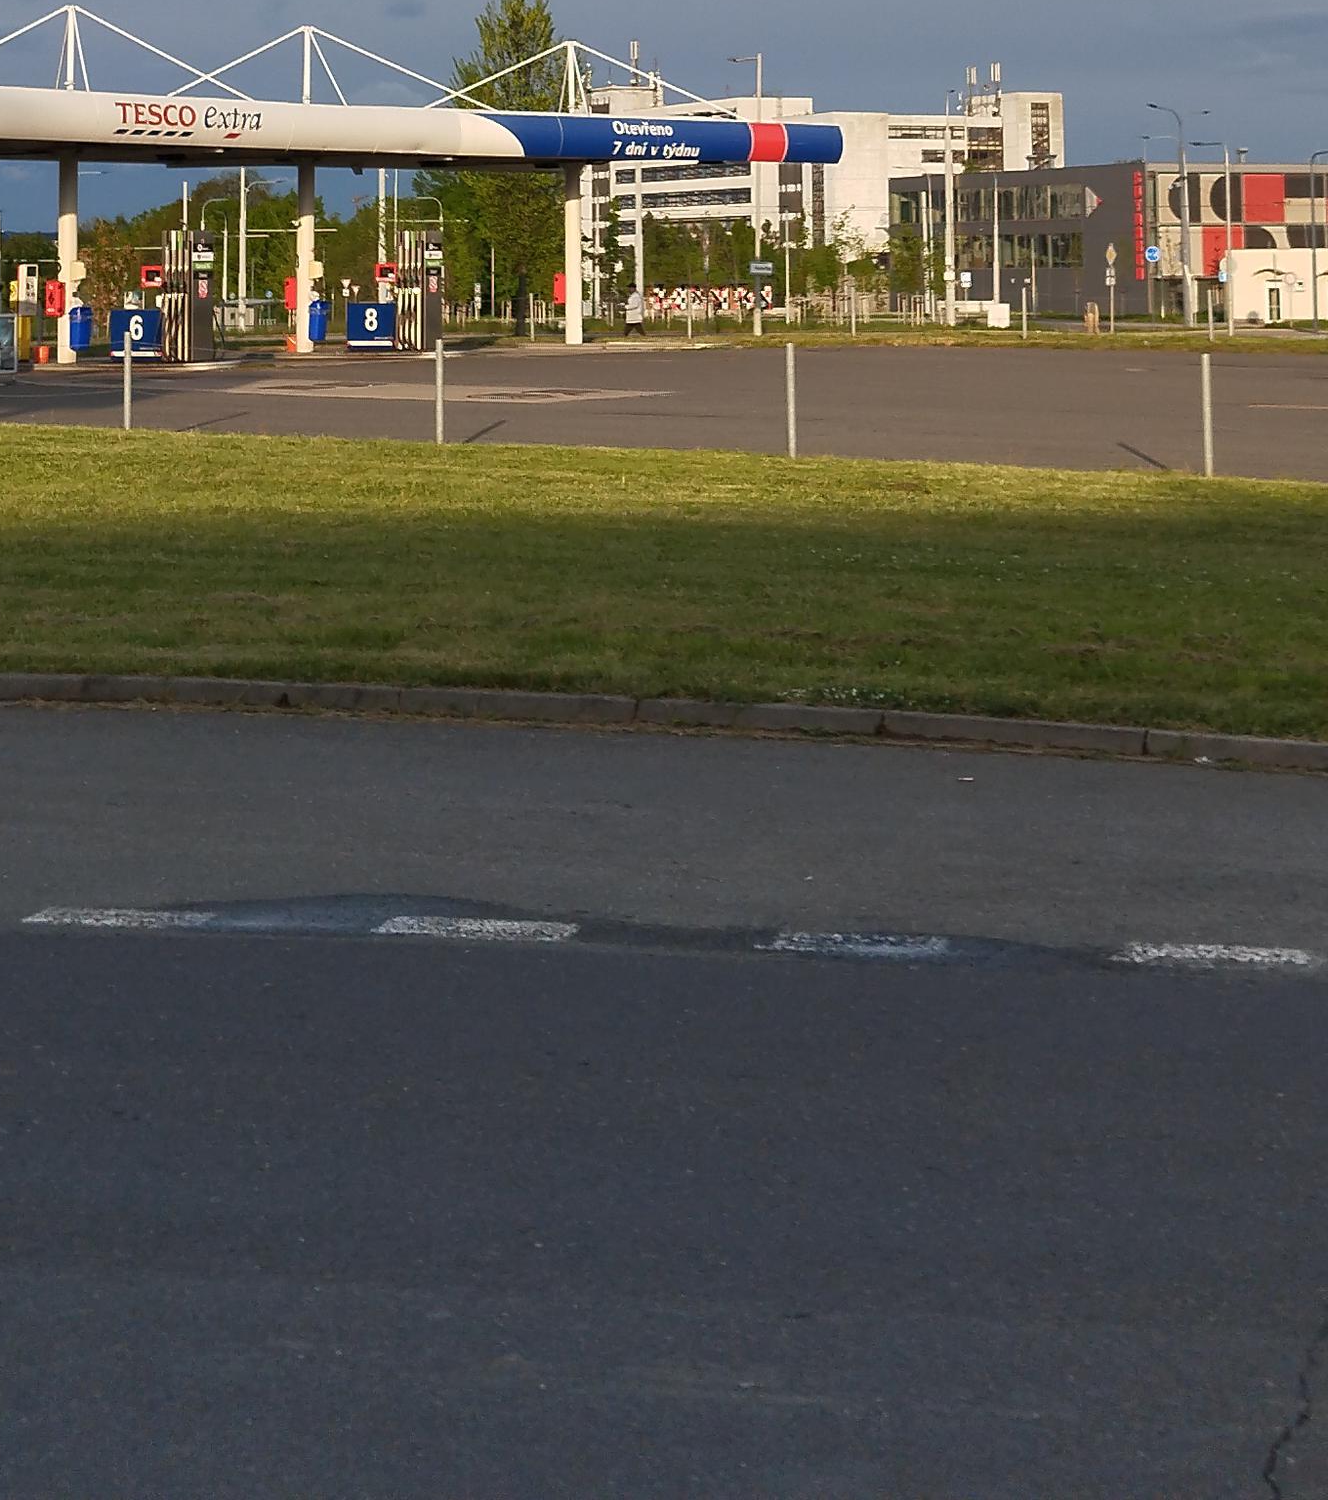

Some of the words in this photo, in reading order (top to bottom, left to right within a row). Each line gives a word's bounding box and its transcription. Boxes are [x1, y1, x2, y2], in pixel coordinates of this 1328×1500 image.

[114, 102, 196, 127] TESCO
[204, 106, 262, 131] extra
[612, 120, 674, 136] Otevřeno
[612, 141, 623, 156] 7
[625, 141, 649, 156] dní
[650, 146, 660, 156] v
[662, 142, 701, 159] týdnu
[129, 315, 144, 341] 6
[364, 308, 378, 332] 8
